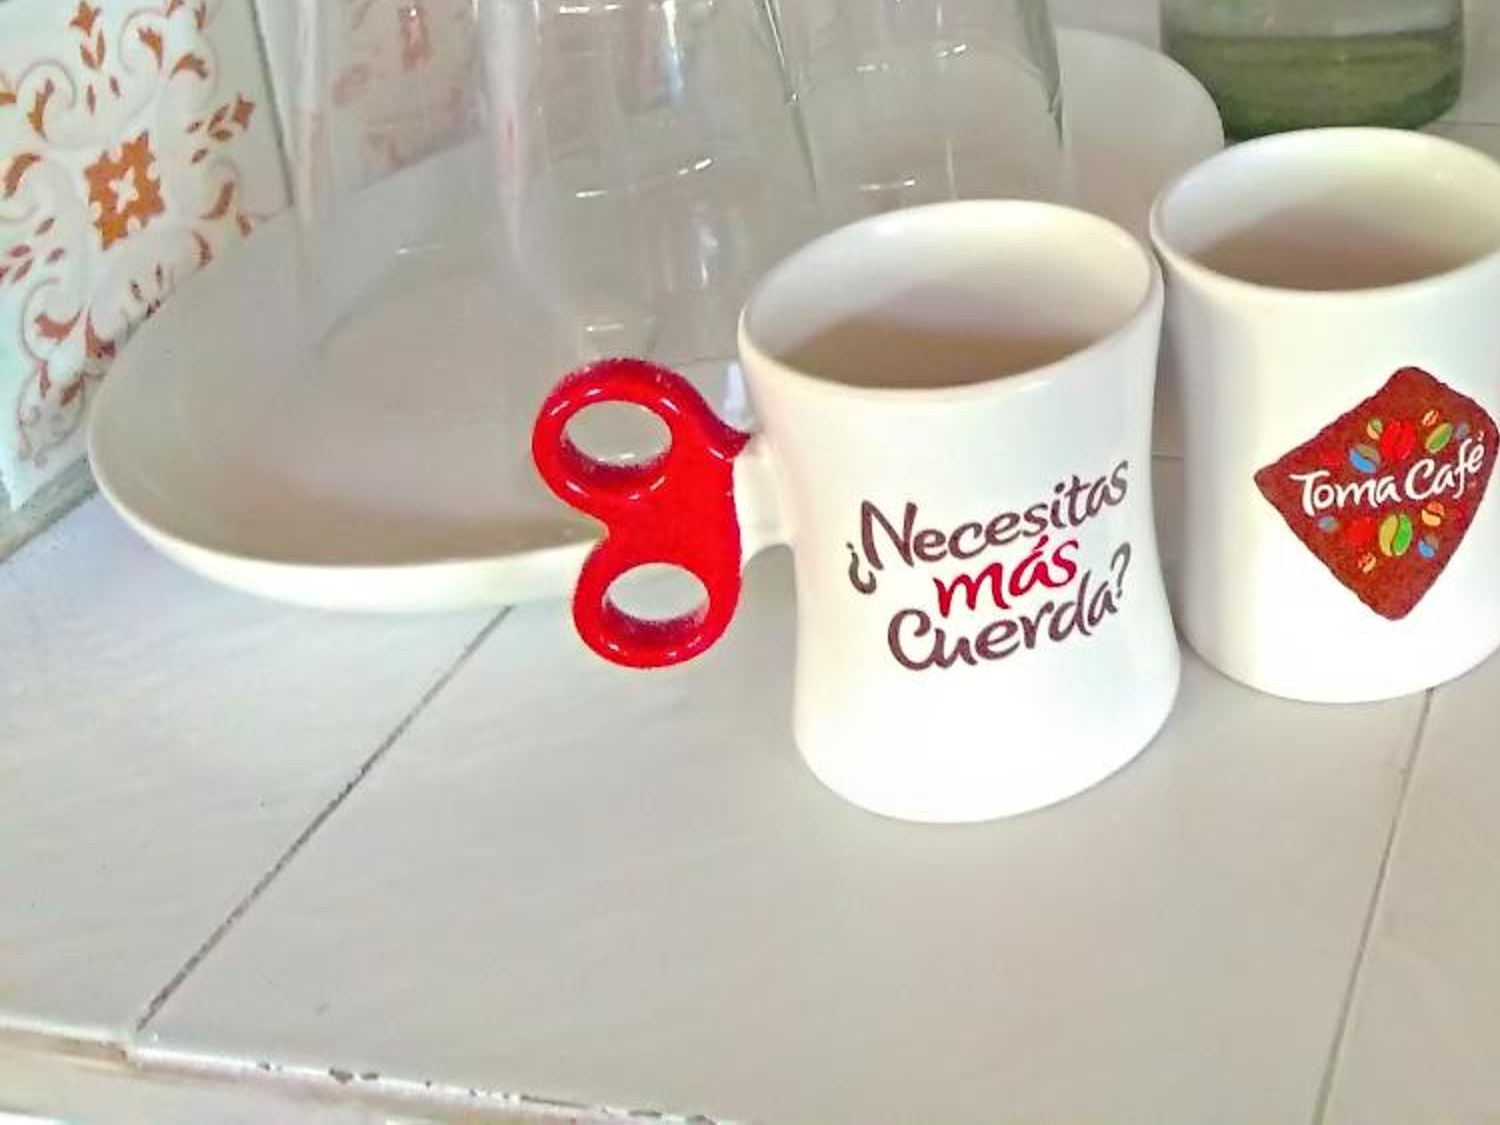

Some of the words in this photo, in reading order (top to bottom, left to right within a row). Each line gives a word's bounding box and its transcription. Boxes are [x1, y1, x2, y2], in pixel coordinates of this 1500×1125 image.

[1289, 469, 1402, 517] Toma
[1404, 430, 1485, 500] Café
[887, 541, 1132, 671] Cuerda?
[933, 534, 1079, 619] más
